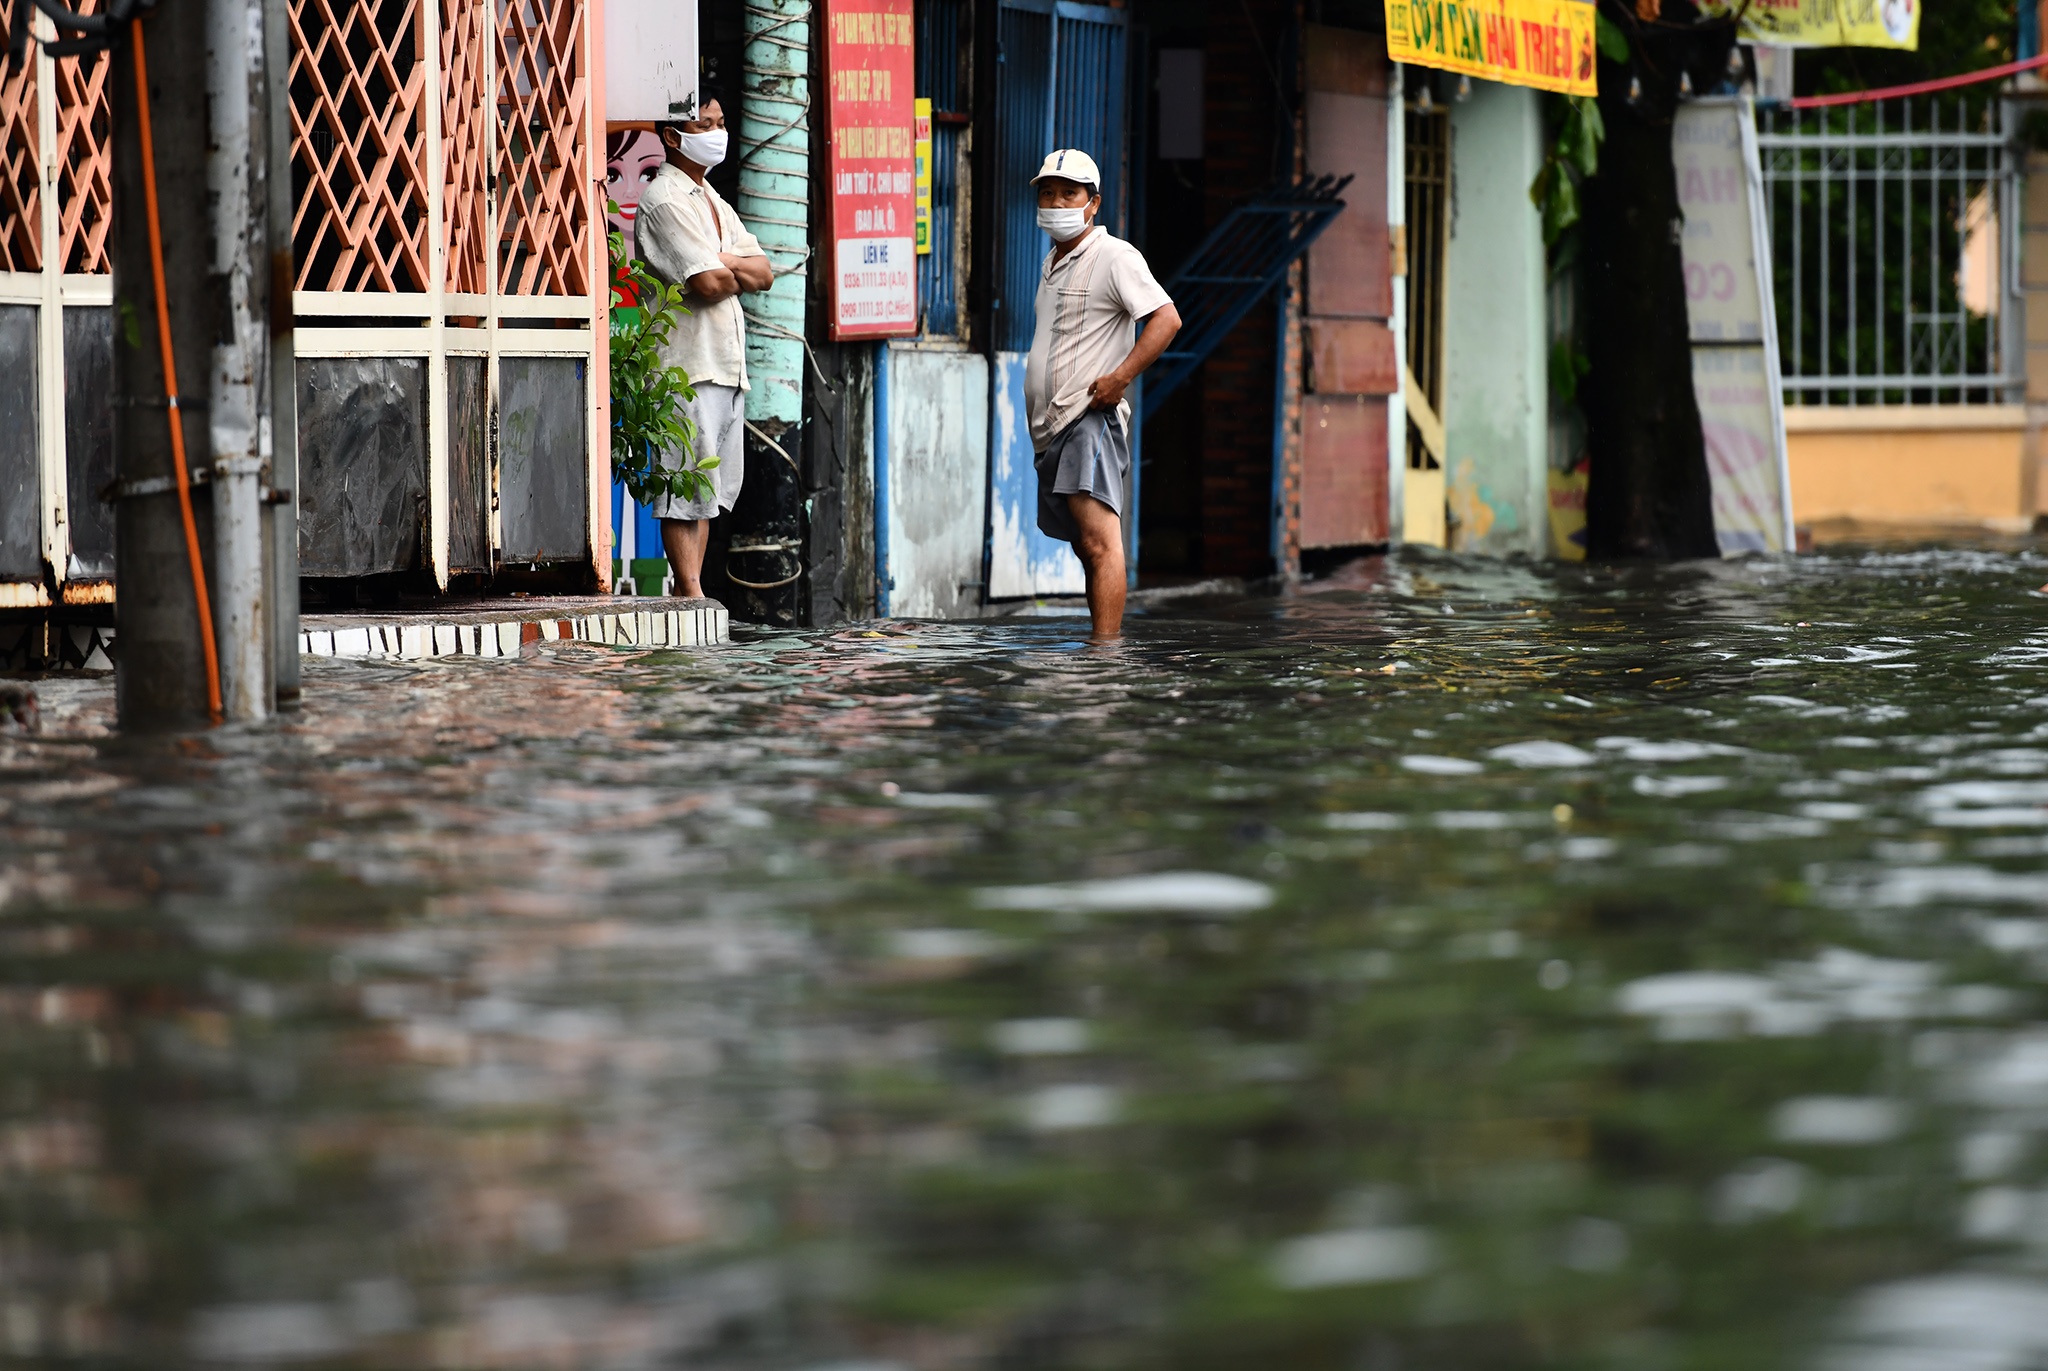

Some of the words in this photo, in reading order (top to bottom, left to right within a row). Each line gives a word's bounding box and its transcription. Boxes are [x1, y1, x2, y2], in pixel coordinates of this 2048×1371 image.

[836, 168, 853, 195] LÀM
[877, 165, 892, 194] CHỦ
[893, 168, 911, 198] NHẬT
[863, 240, 878, 264] LIÊN
[880, 240, 888, 267] HỆ
[844, 272, 887, 288] 0336.1111.33
[841, 301, 884, 318] 0909.1111.33
